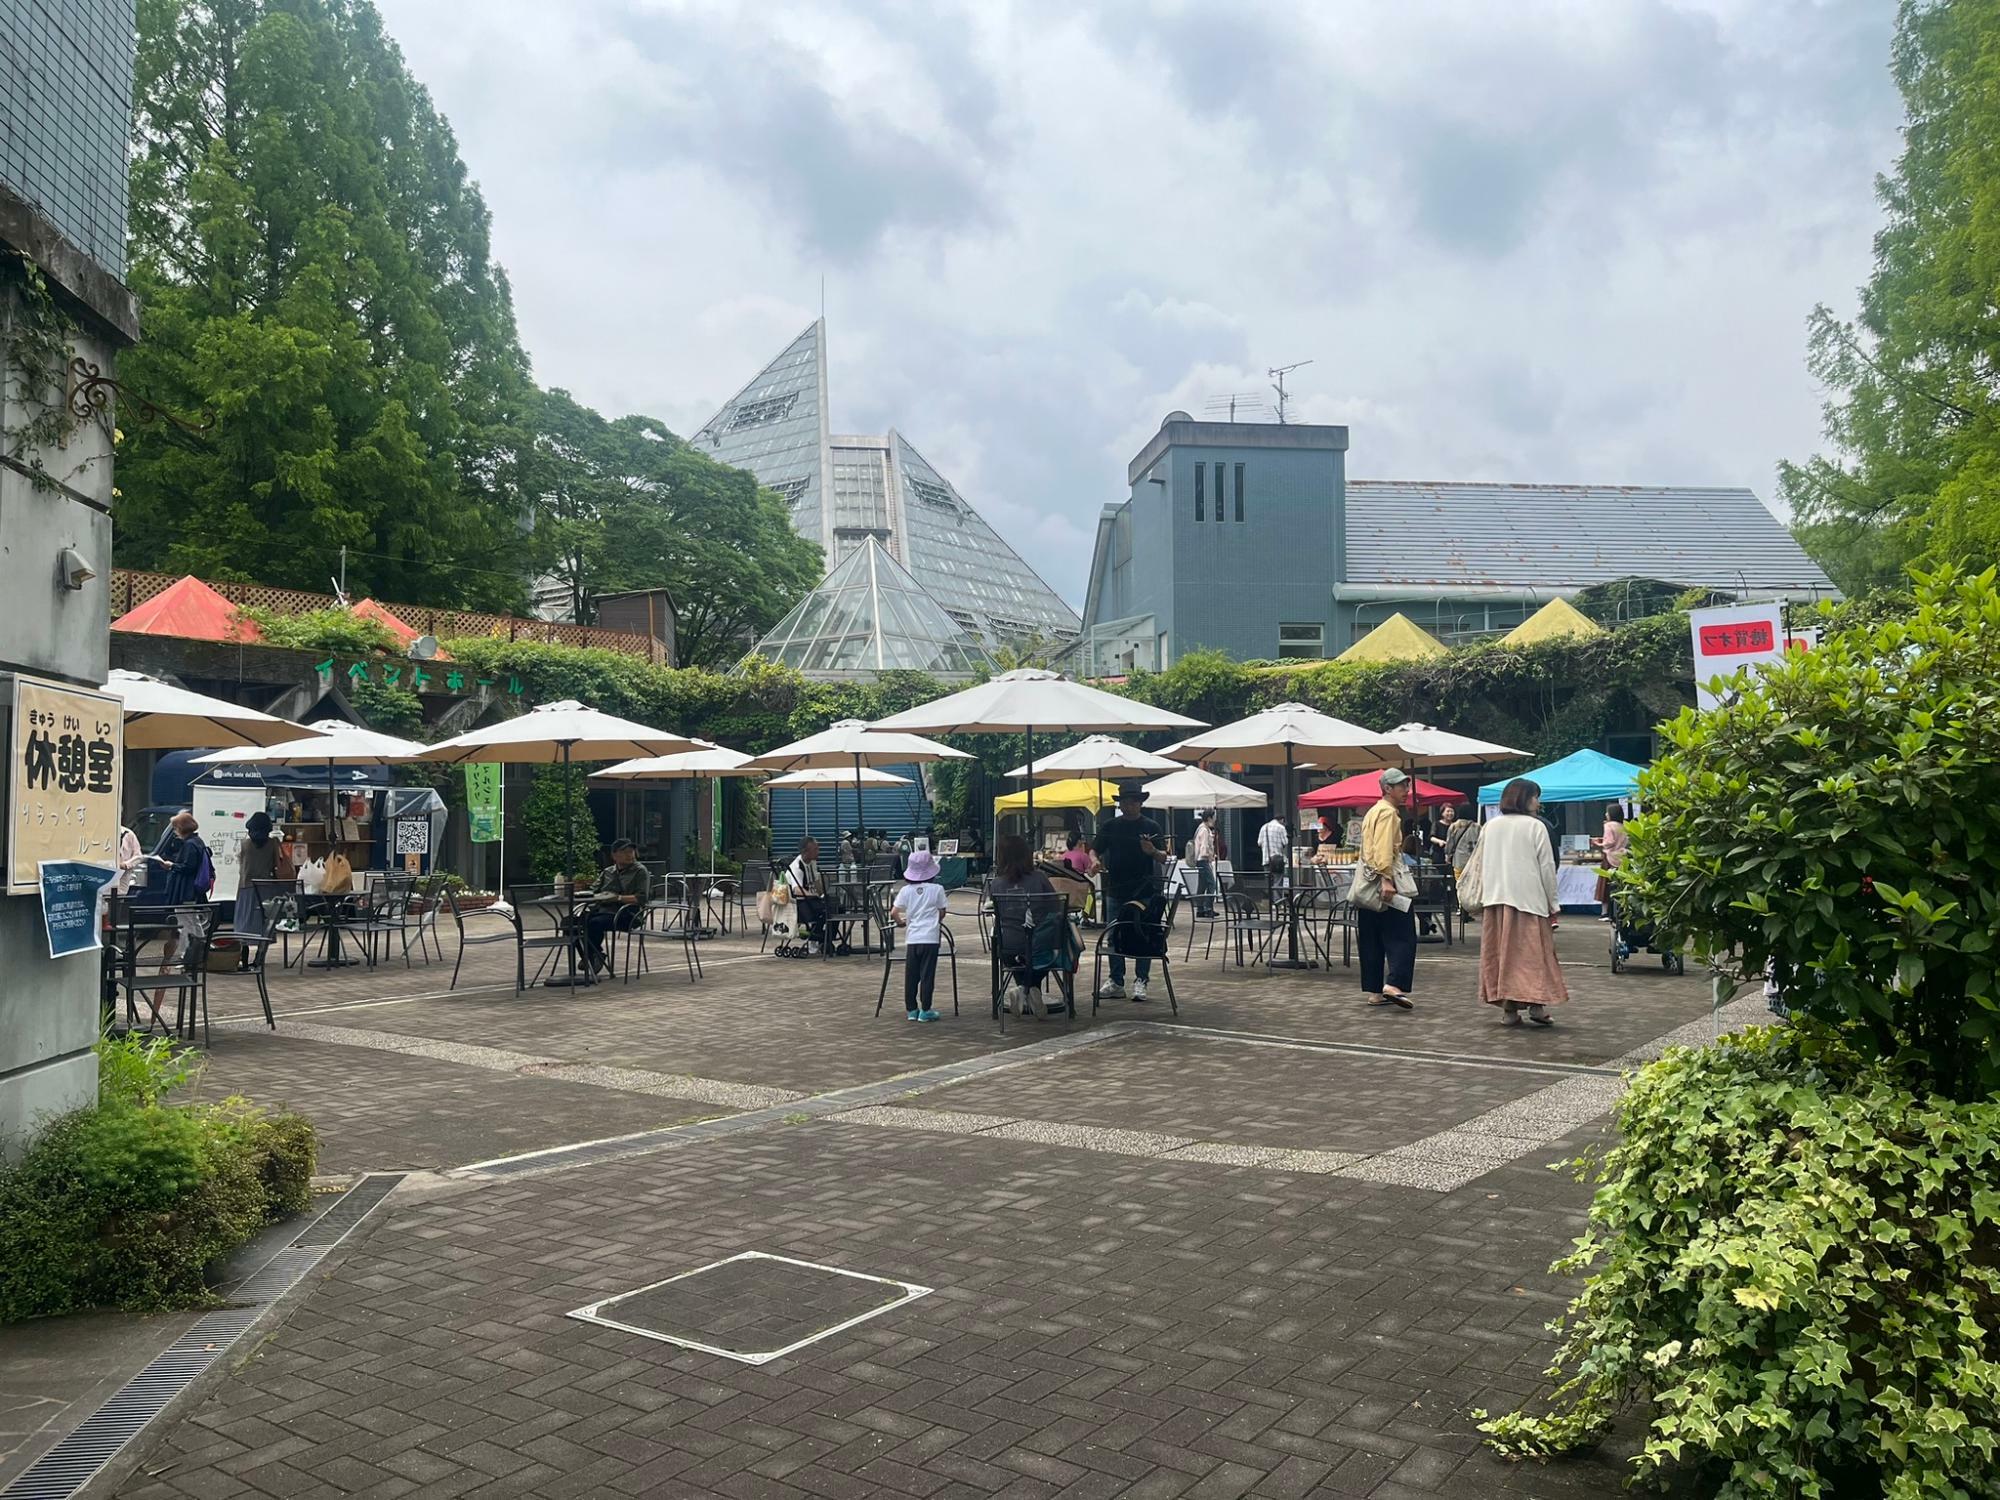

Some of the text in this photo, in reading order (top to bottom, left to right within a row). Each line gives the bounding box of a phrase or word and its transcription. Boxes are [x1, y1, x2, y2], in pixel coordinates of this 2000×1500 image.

[314, 658, 524, 695] イベントホール
[30, 709, 111, 735] きゅう けい しつ
[25, 729, 114, 793] 休憩室
[79, 835, 112, 854] ルーム
